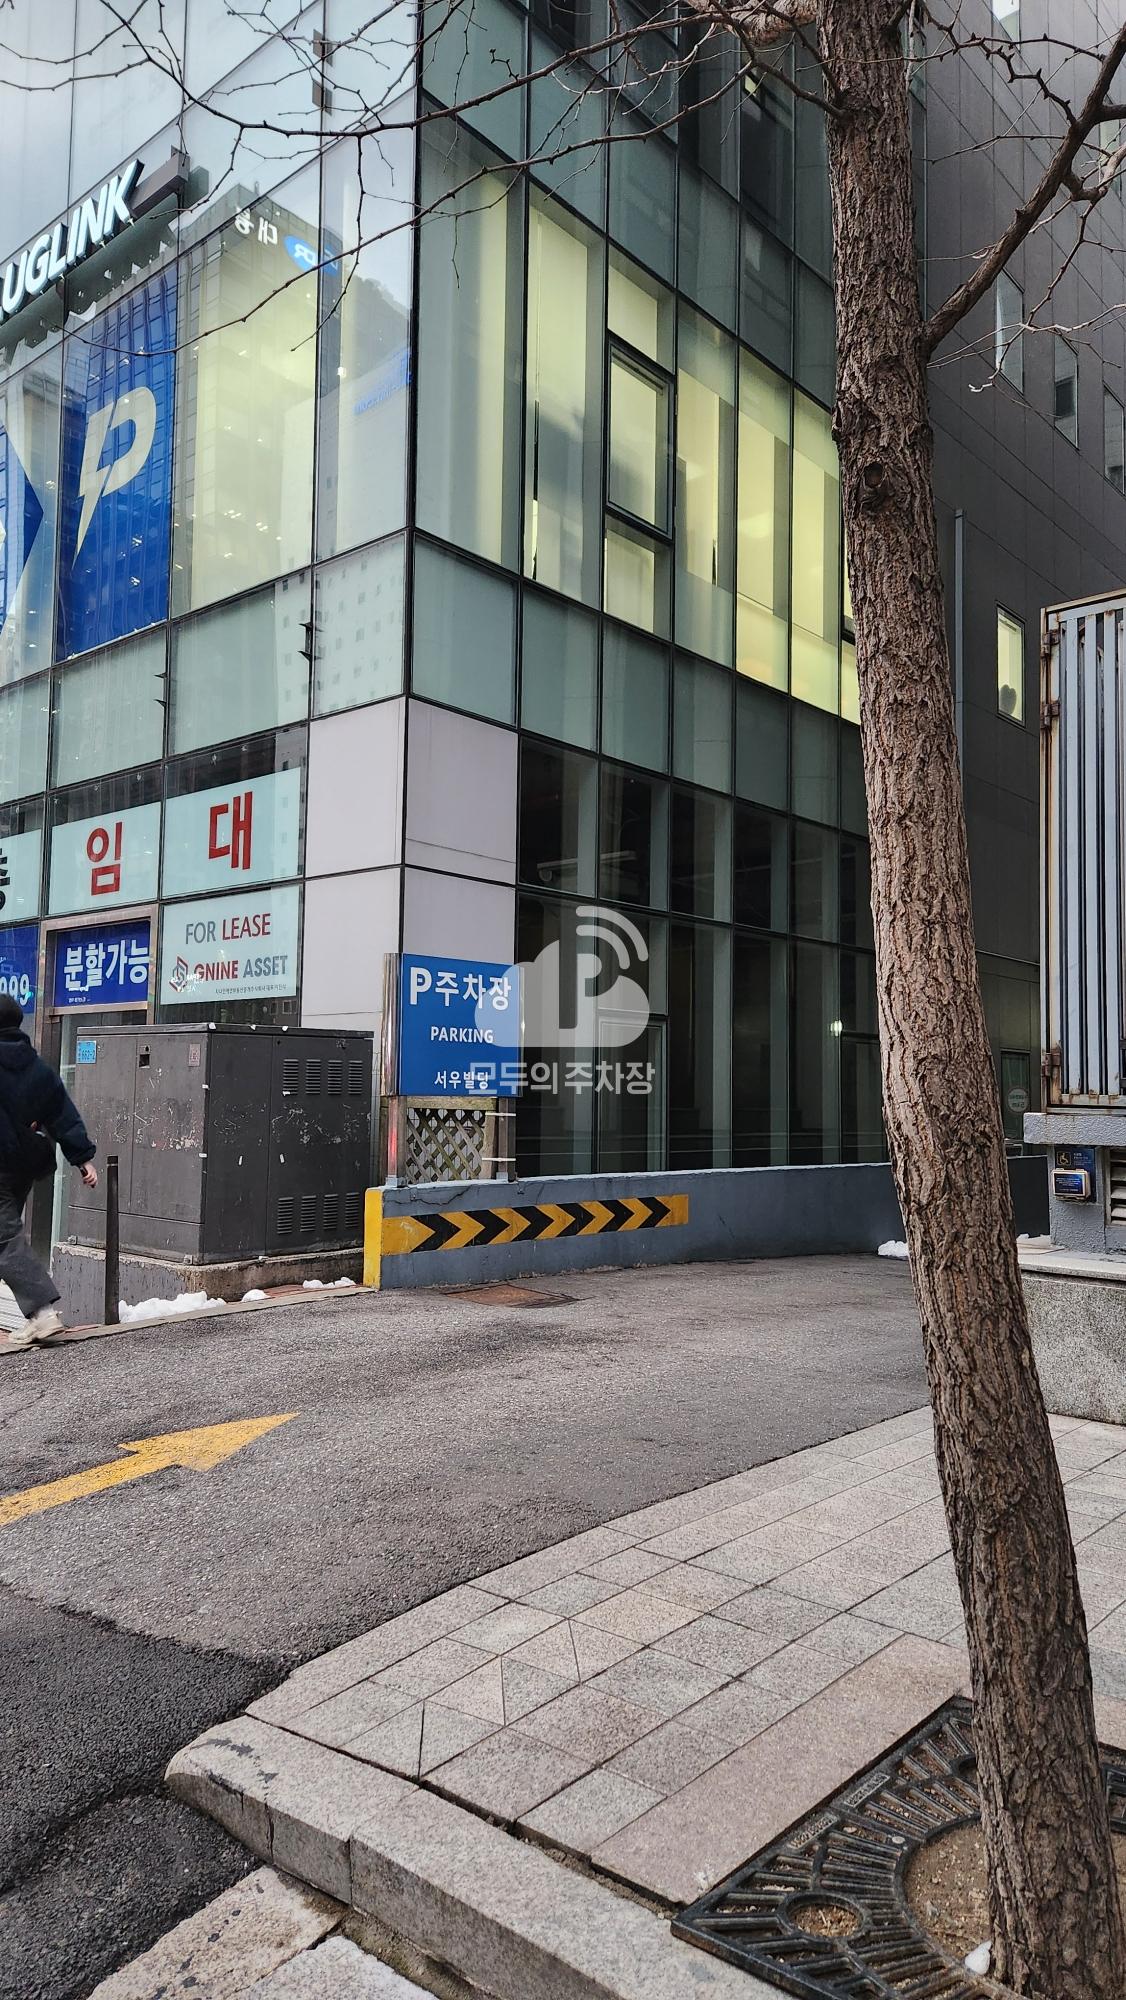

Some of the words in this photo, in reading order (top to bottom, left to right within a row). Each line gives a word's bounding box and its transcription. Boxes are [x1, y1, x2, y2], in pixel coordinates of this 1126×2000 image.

[0, 159, 143, 324] UGLINK
[185, 920, 216, 945] FOR
[222, 913, 271, 941] LEASE
[63, 939, 150, 989] 분할가능
[194, 960, 239, 982] GNINE
[243, 955, 288, 979] ASSET
[430, 1026, 494, 1044] PARKING
[434, 1070, 489, 1090] 서우빌딩
